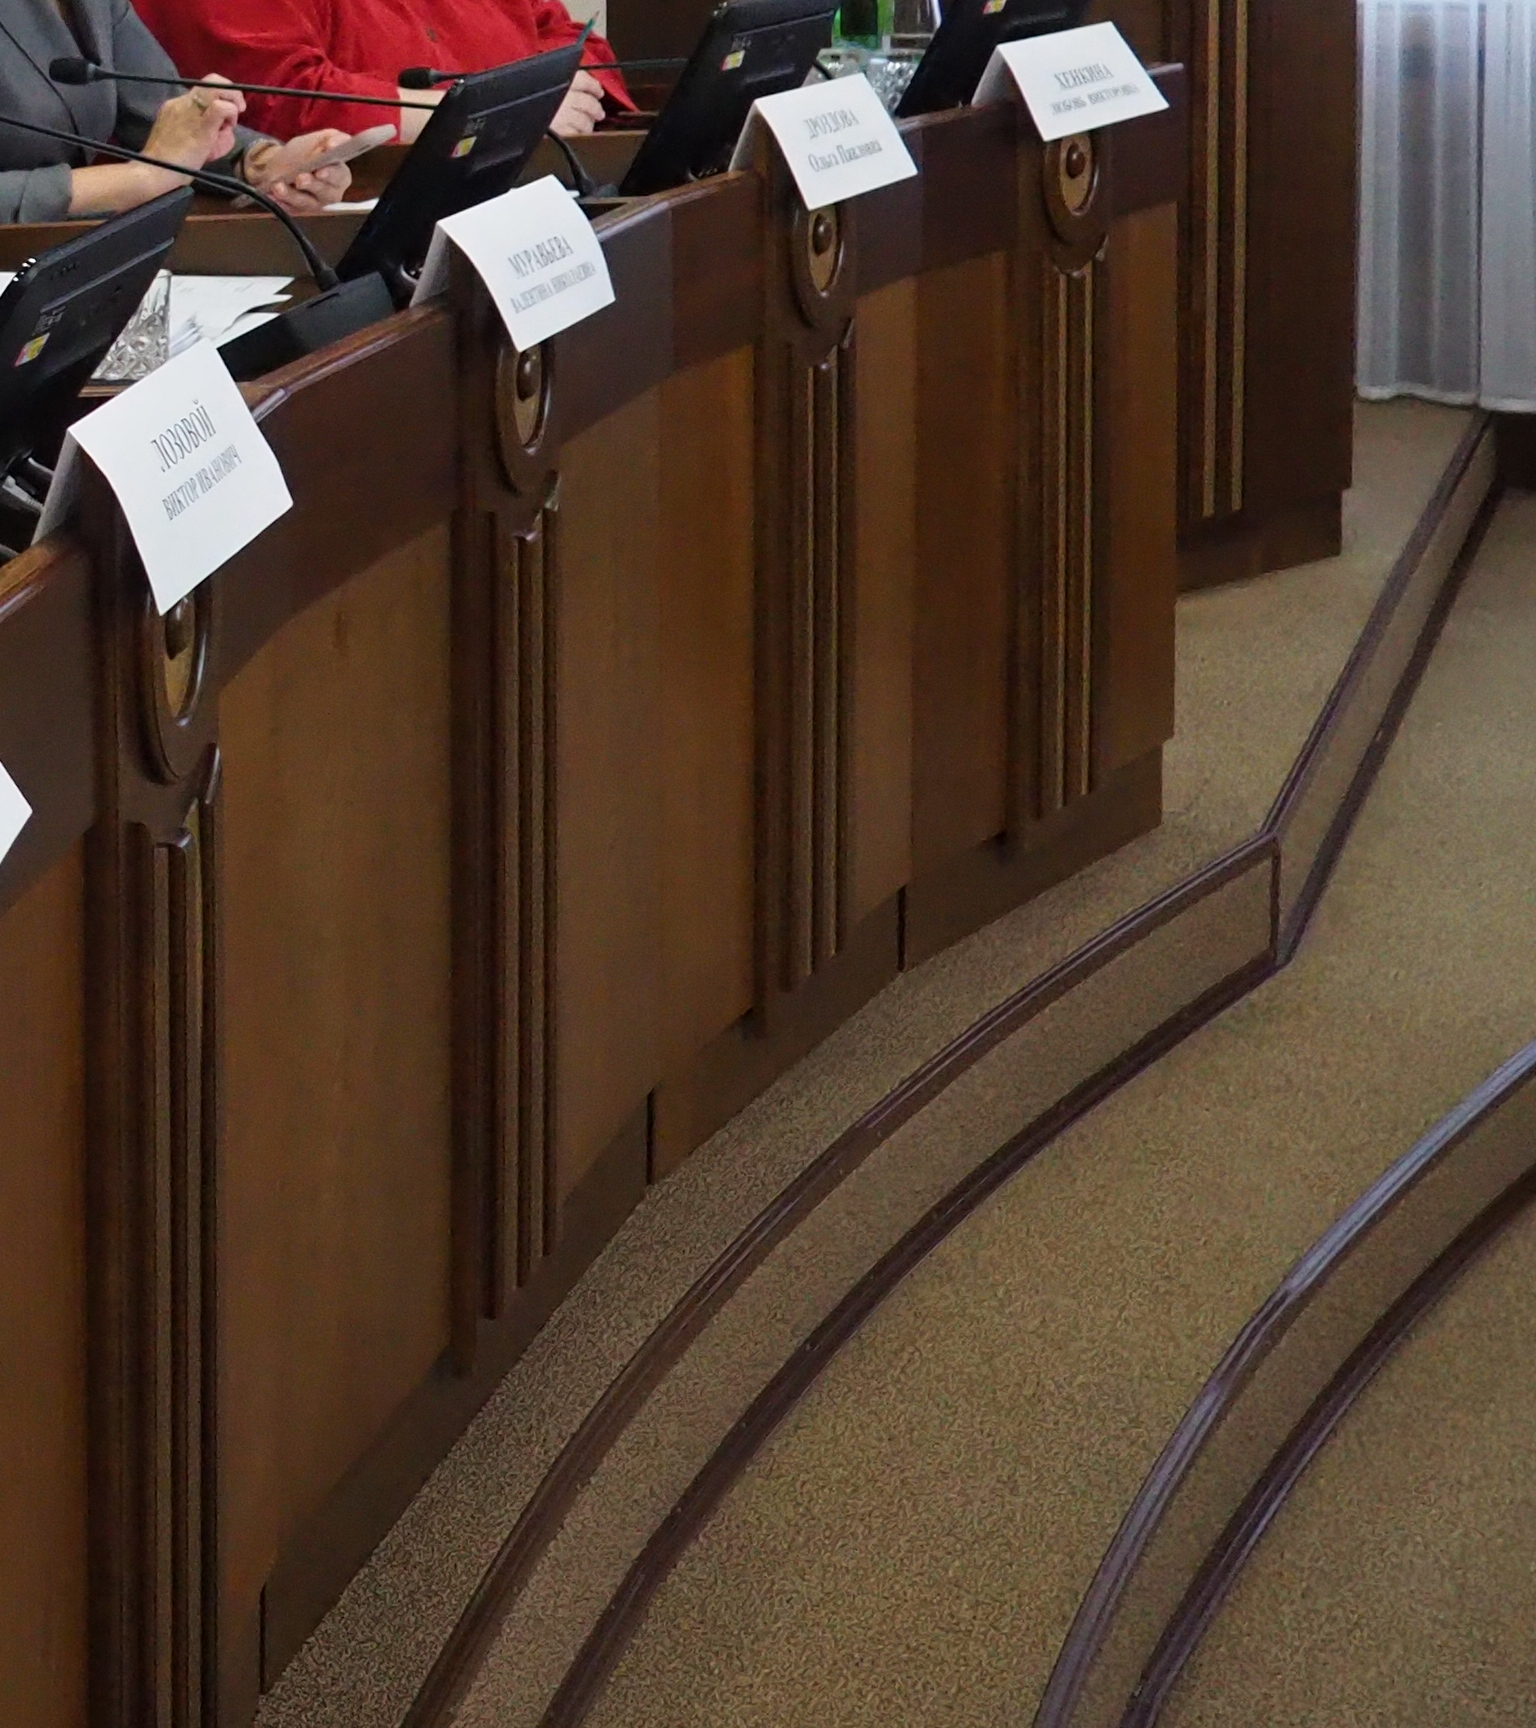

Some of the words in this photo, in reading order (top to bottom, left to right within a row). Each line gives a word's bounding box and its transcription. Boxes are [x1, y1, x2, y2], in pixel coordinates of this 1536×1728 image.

[507, 235, 574, 280] МУРАВЬЕВА
[150, 398, 217, 473] ЛОЗОВОЙ
[162, 477, 199, 521] ВИКТОР
[195, 444, 242, 494] ИВАНОВИЧ
